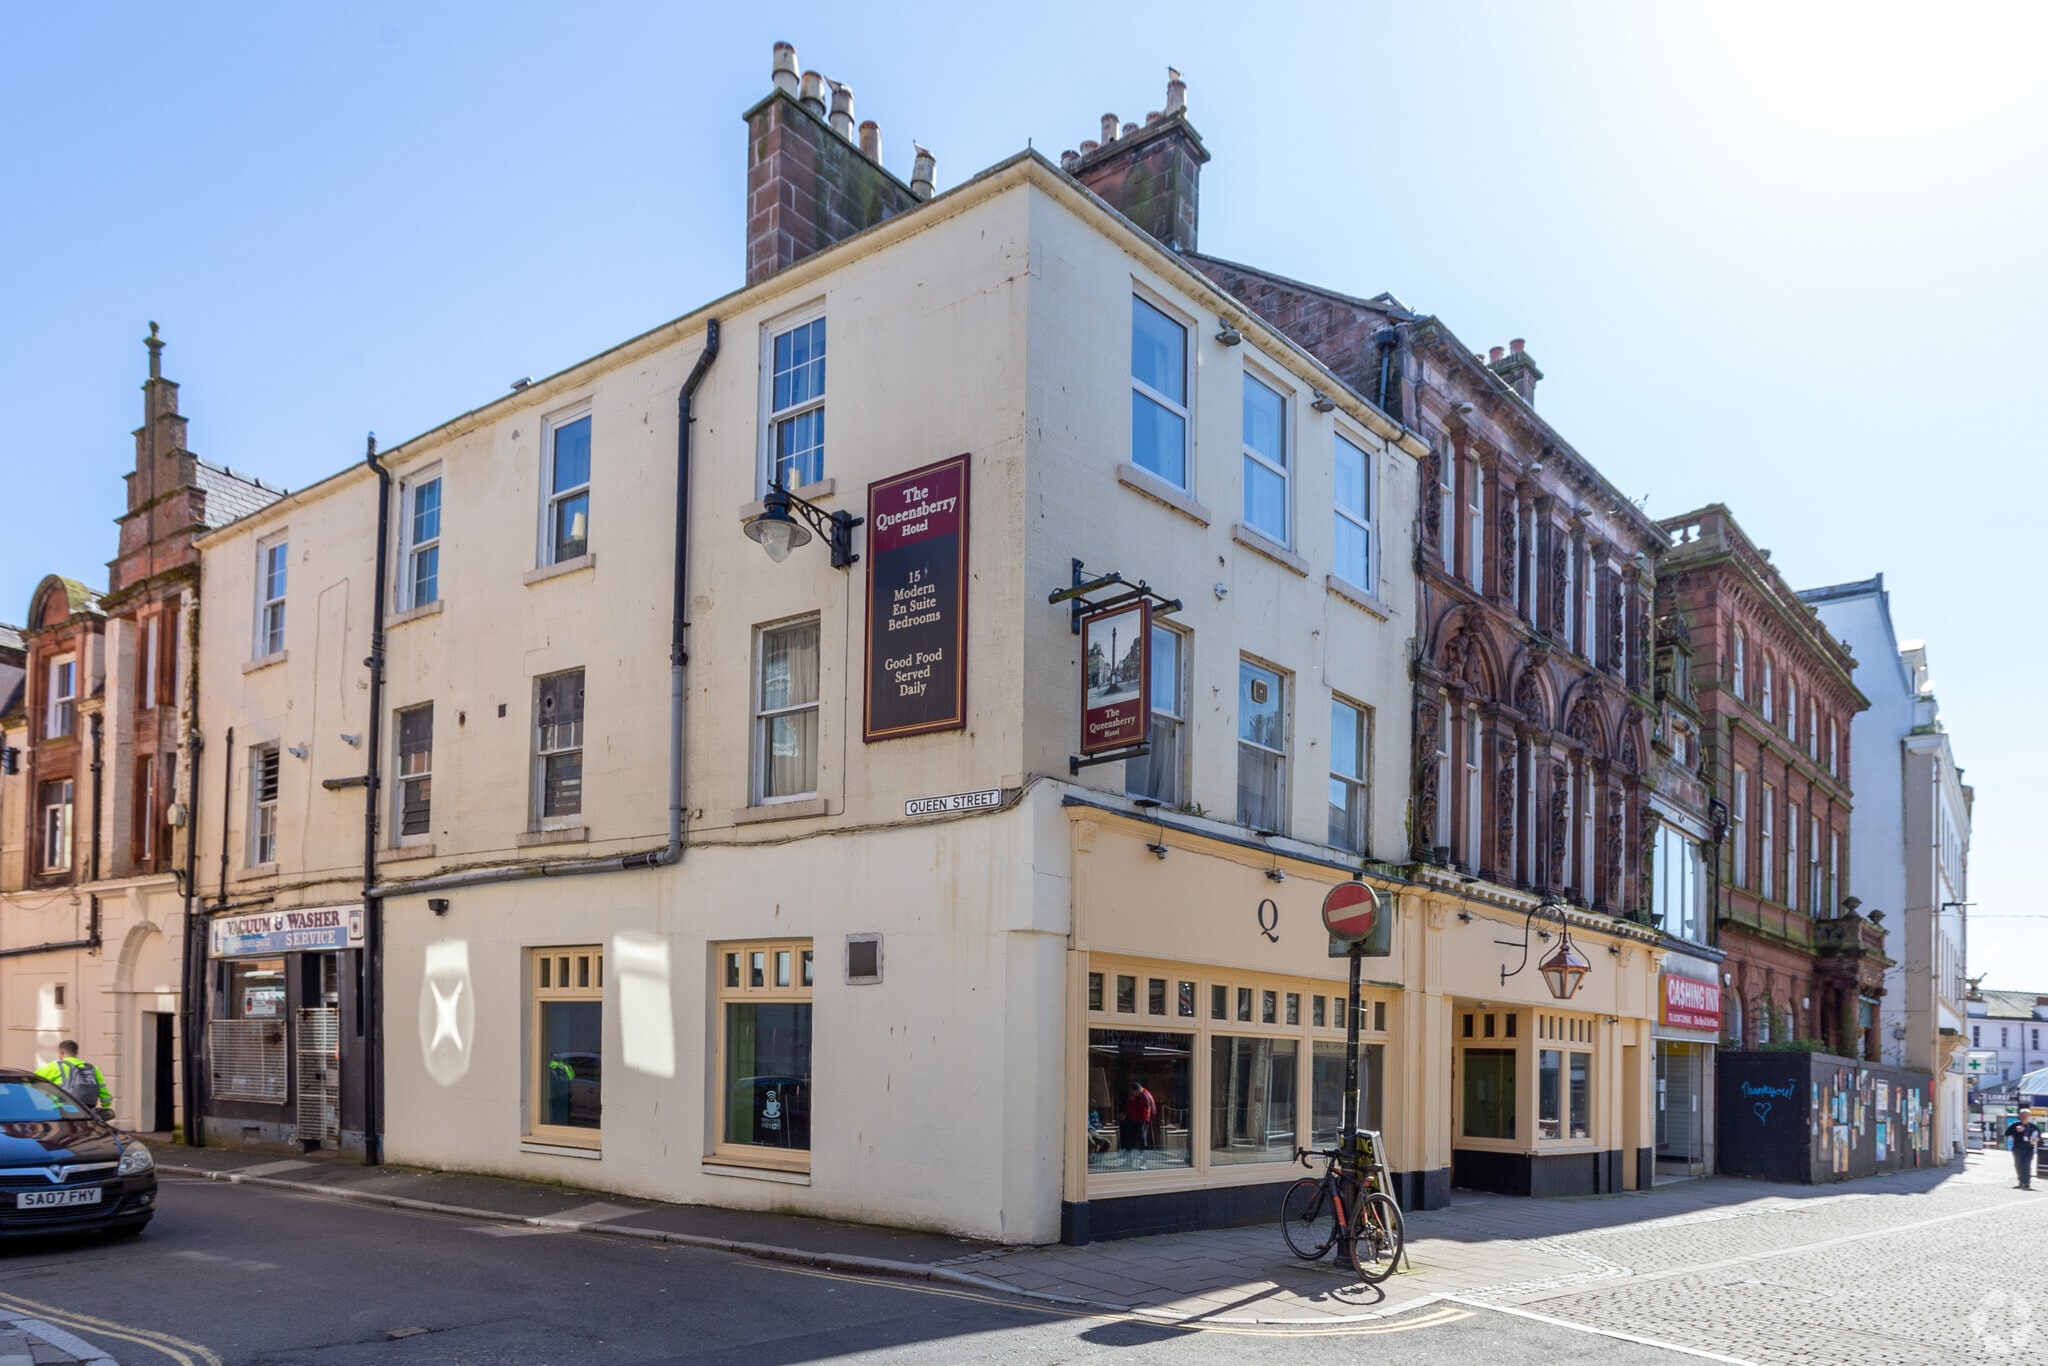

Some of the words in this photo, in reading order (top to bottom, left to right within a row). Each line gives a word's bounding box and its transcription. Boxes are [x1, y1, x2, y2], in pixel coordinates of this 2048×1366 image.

[903, 486, 929, 503] The
[876, 497, 957, 531] Queensberry
[902, 519, 929, 536] Hotel
[909, 570, 921, 583] 15
[894, 584, 935, 601] Modern
[892, 603, 907, 616] En
[909, 597, 937, 612] Suite
[888, 611, 941, 631] Bedrooms
[885, 653, 913, 671] Good
[915, 648, 943, 665] Food
[895, 665, 931, 683] Served
[899, 681, 927, 697] Daily
[1104, 708, 1120, 718] The
[1089, 716, 1136, 734] Queensberry
[1104, 728, 1120, 738] Hotel
[910, 799, 948, 814] QUEEN
[953, 792, 995, 808] STREET
[227, 917, 271, 935] VACUUM
[286, 910, 340, 929] WASHER
[1258, 898, 1280, 943] Q
[285, 929, 336, 947] SERVICE
[1705, 986, 1719, 1013] INN
[25, 1191, 65, 1206] SA07
[69, 1189, 96, 1203] FHY
